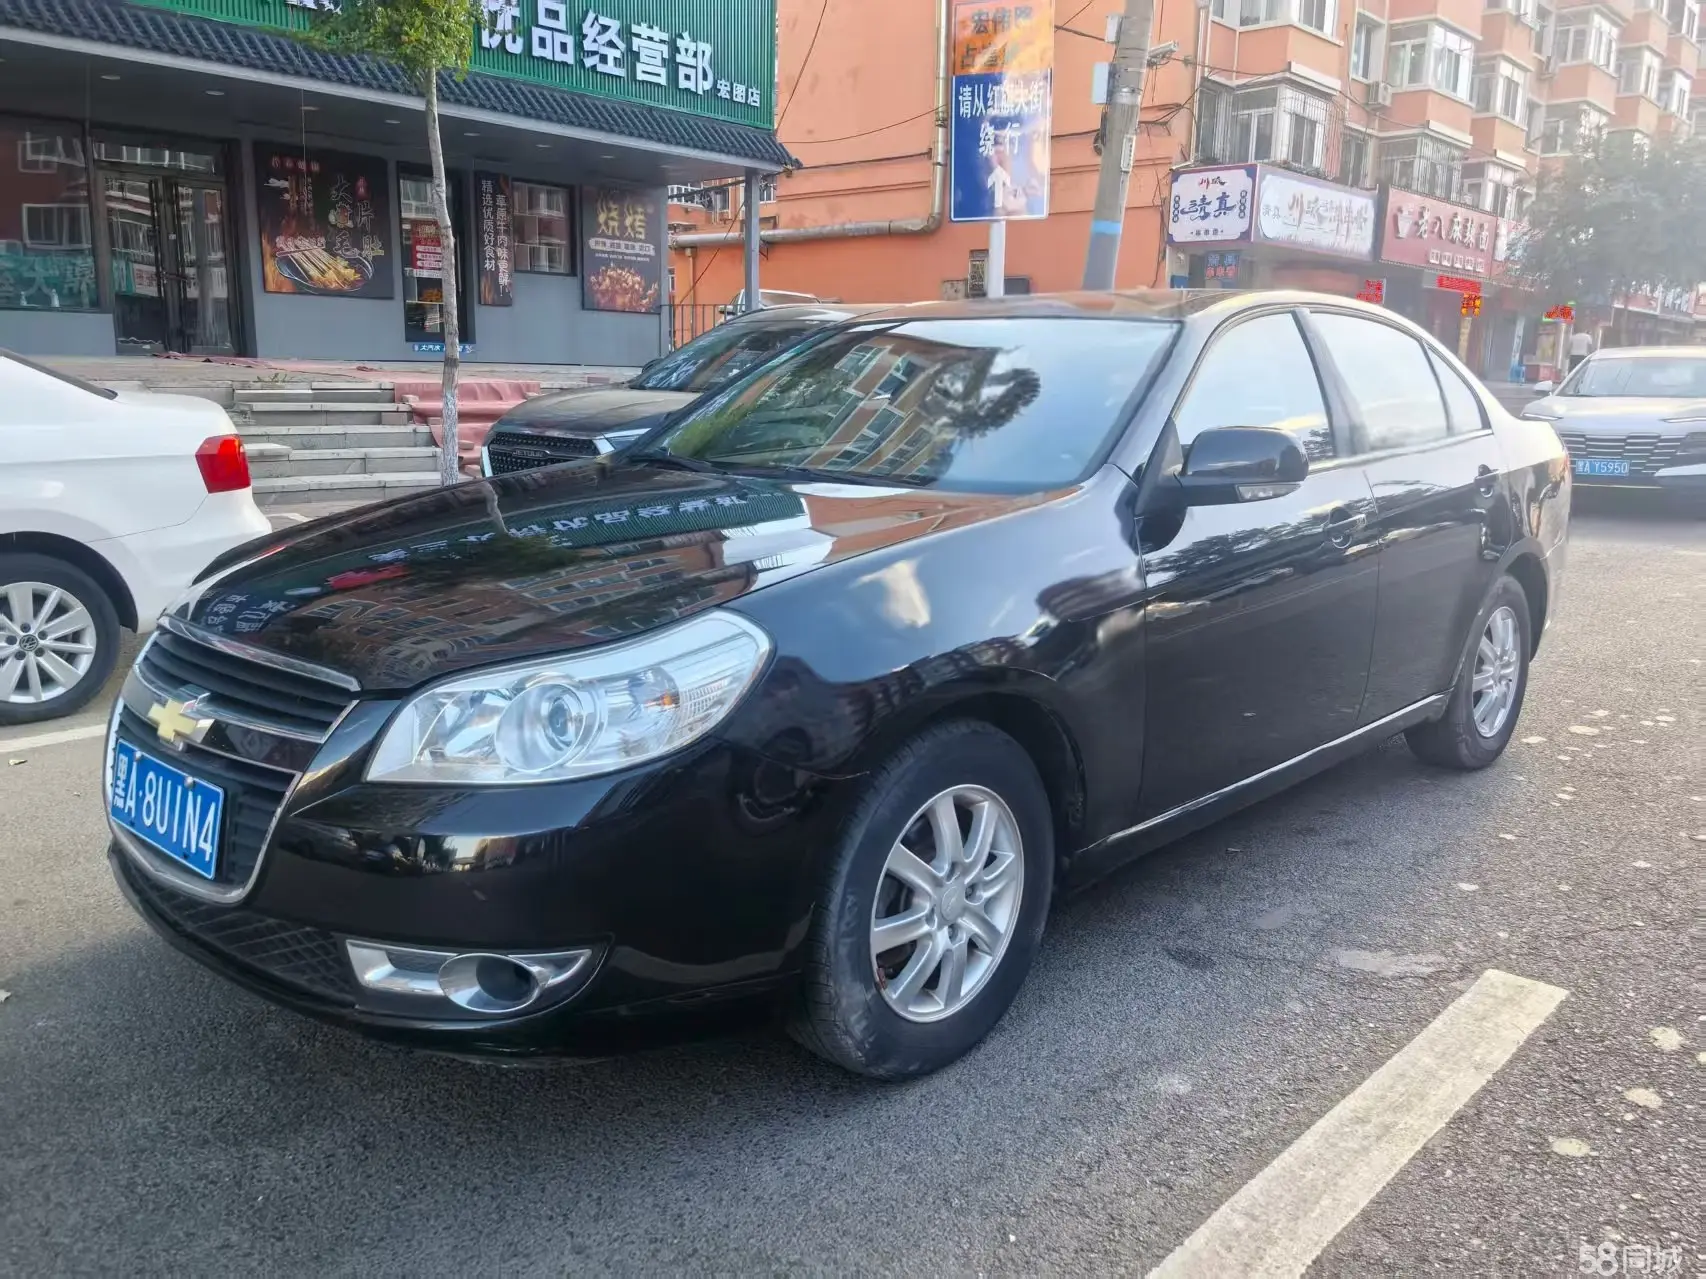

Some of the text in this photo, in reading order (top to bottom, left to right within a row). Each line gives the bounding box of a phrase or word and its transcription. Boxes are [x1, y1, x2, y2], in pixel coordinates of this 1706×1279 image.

[717, 79, 761, 107] 宏图店
[958, 81, 1046, 119] 请从红旗大街
[978, 121, 1022, 156] 绕行
[482, 179, 496, 271] 精选优质好食材
[597, 194, 647, 239] 烧烤
